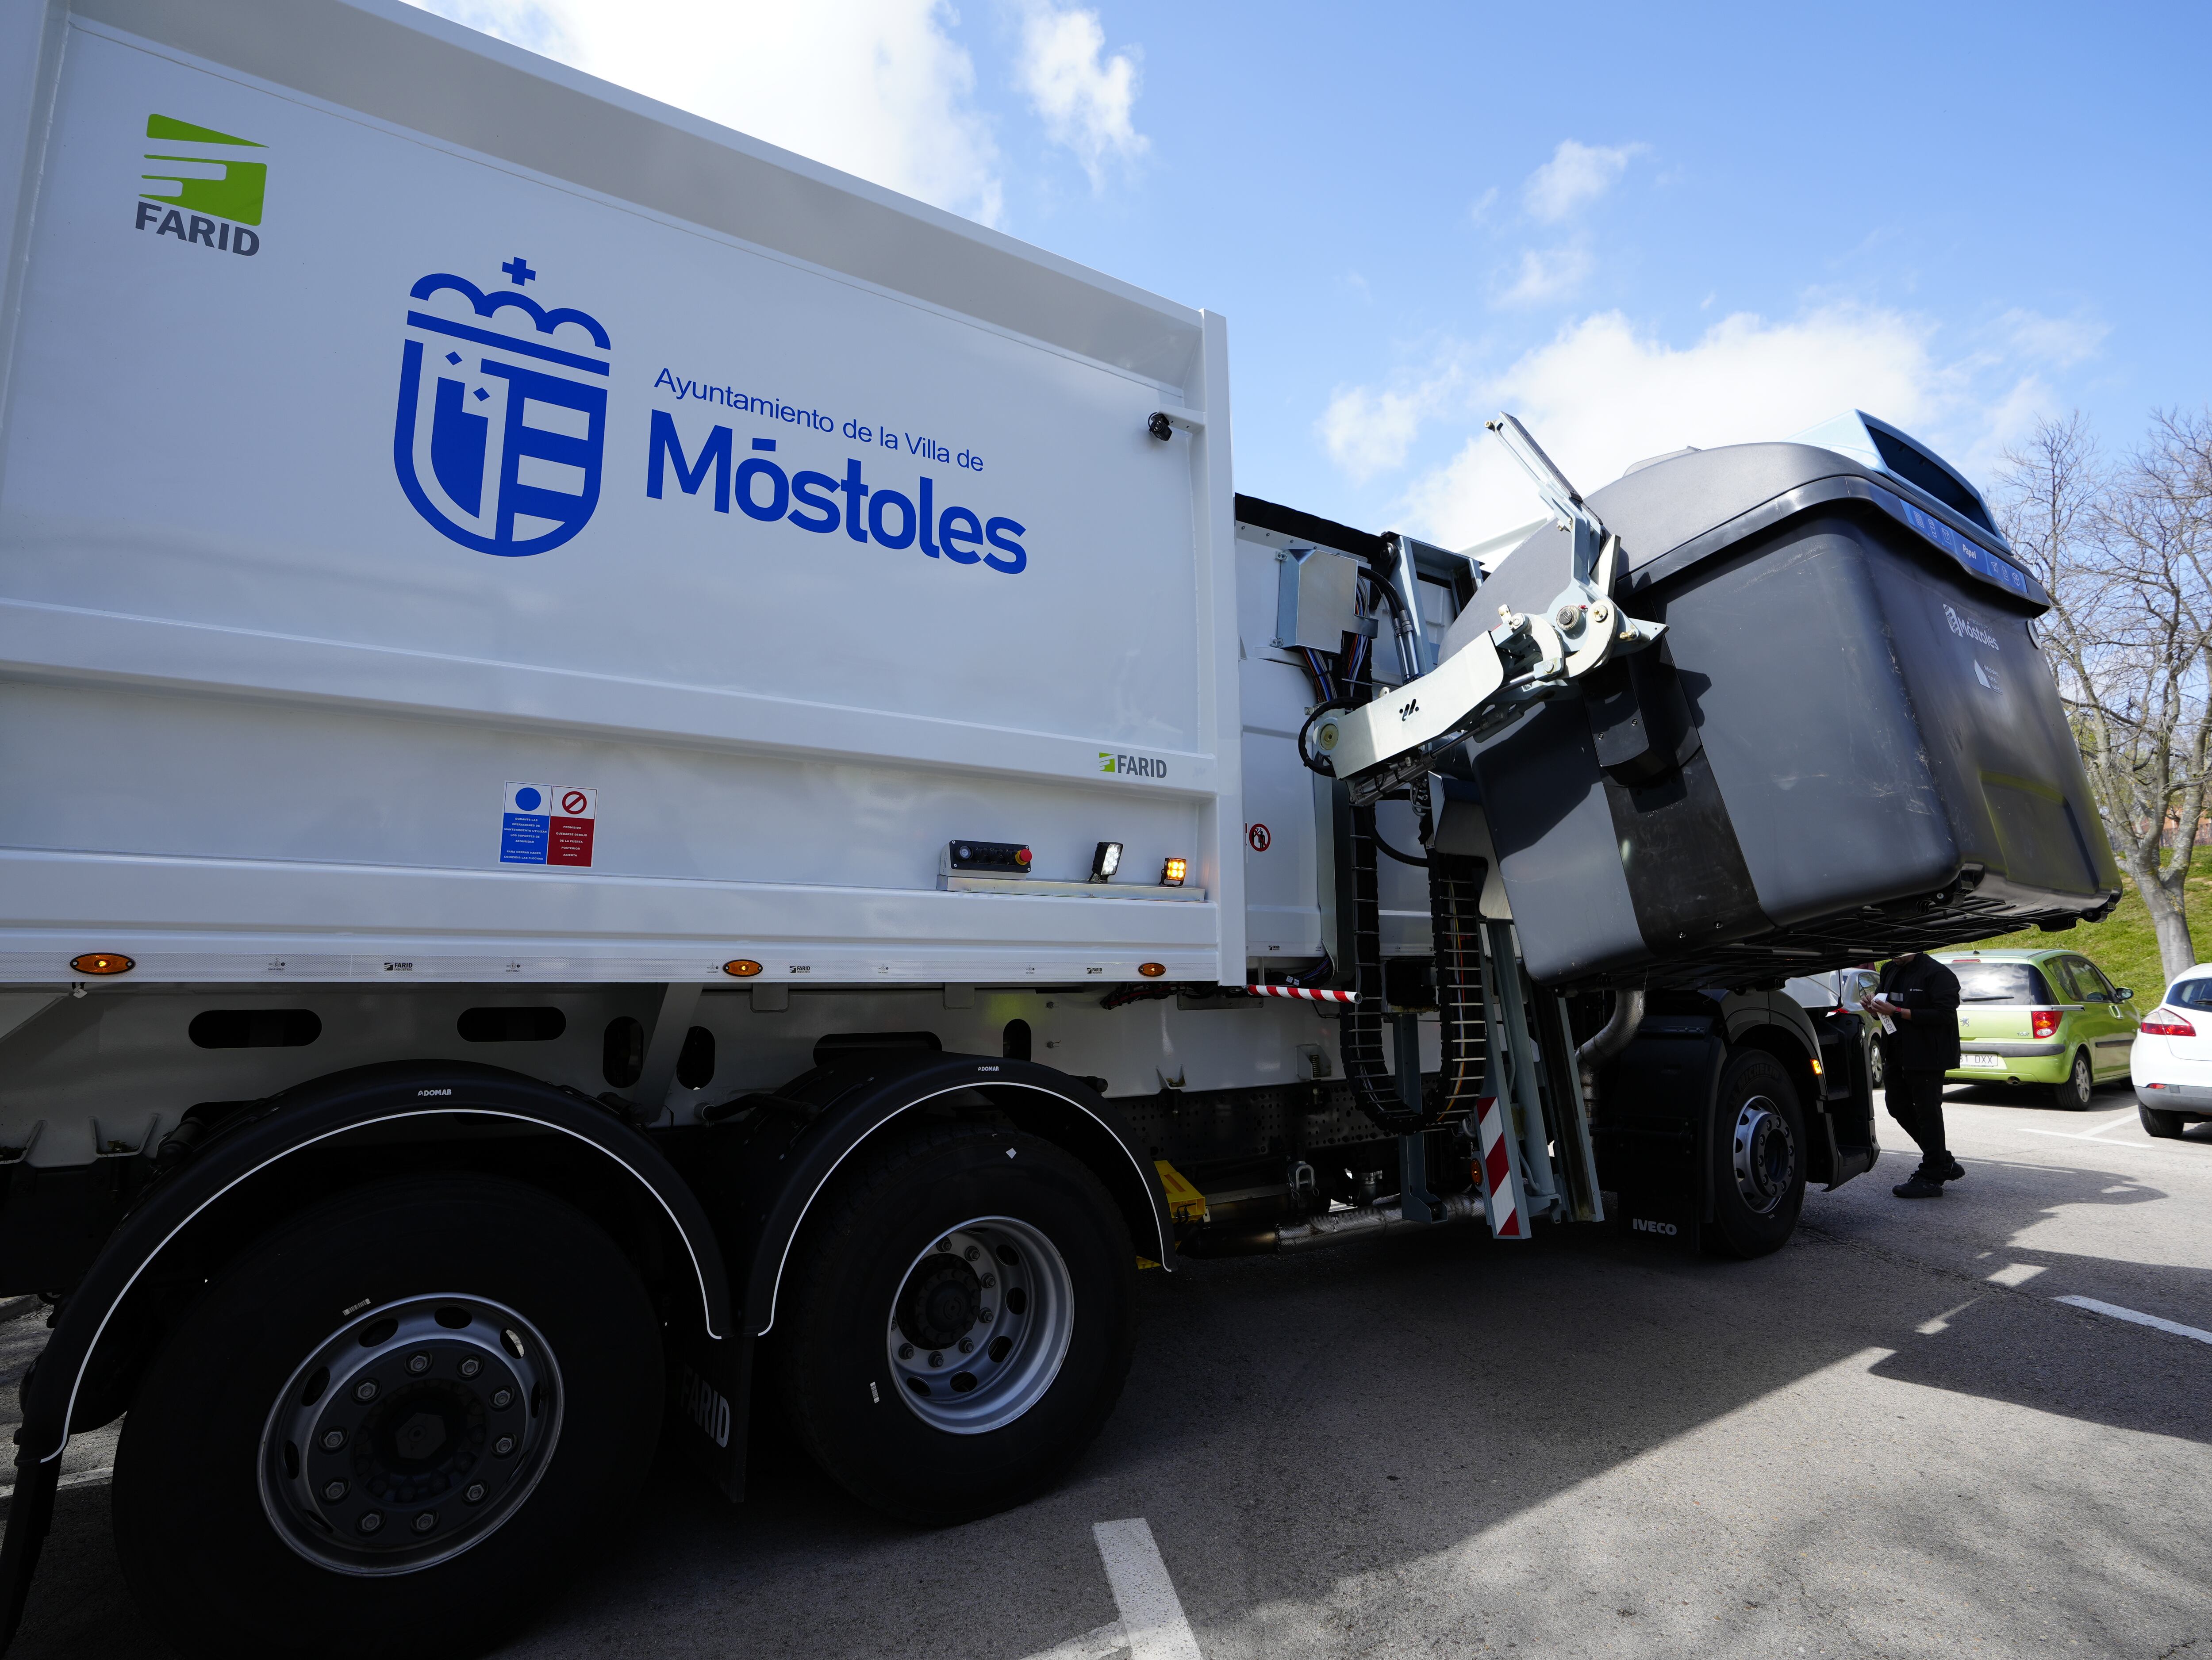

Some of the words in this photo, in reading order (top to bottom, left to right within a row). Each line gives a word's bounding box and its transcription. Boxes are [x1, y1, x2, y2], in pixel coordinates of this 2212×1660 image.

[135, 201, 260, 257] FARID
[654, 368, 834, 432] Ayuntamiento
[842, 418, 872, 442] de
[880, 426, 898, 450] la
[905, 433, 950, 463] Villa
[956, 449, 983, 472] de
[1962, 544, 1977, 559] Papel
[1958, 617, 1999, 651] Móstoles
[1117, 755, 1167, 778] FARID
[1881, 1013, 1894, 1031] aser
[1975, 1055, 1993, 1064] DXX
[1737, 1063, 1780, 1091] MICHELIN
[1633, 1218, 1677, 1235] IVECO
[680, 1362, 730, 1449] FARID
